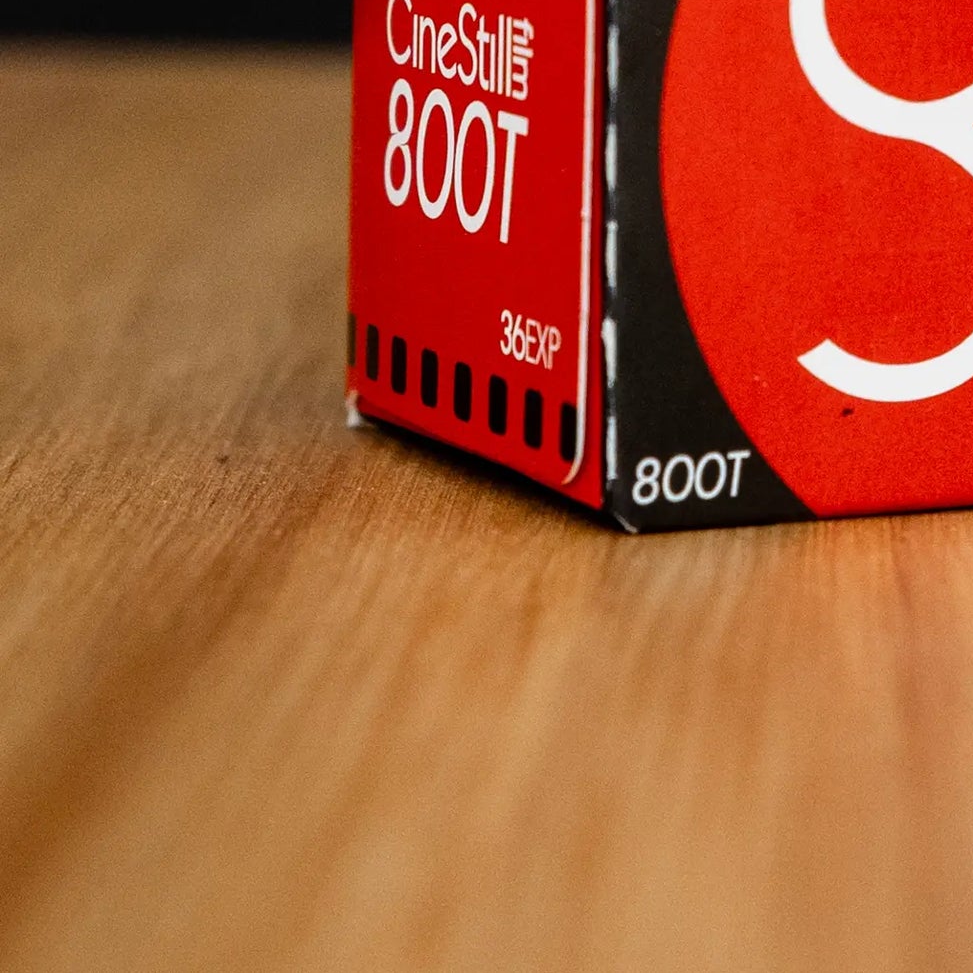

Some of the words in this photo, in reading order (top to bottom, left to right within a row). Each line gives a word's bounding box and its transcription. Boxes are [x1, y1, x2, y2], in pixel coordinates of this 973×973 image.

[512, 18, 535, 102] film
[383, 78, 530, 245] 800T
[499, 309, 563, 371] 36EXP
[632, 449, 752, 506] 800T
